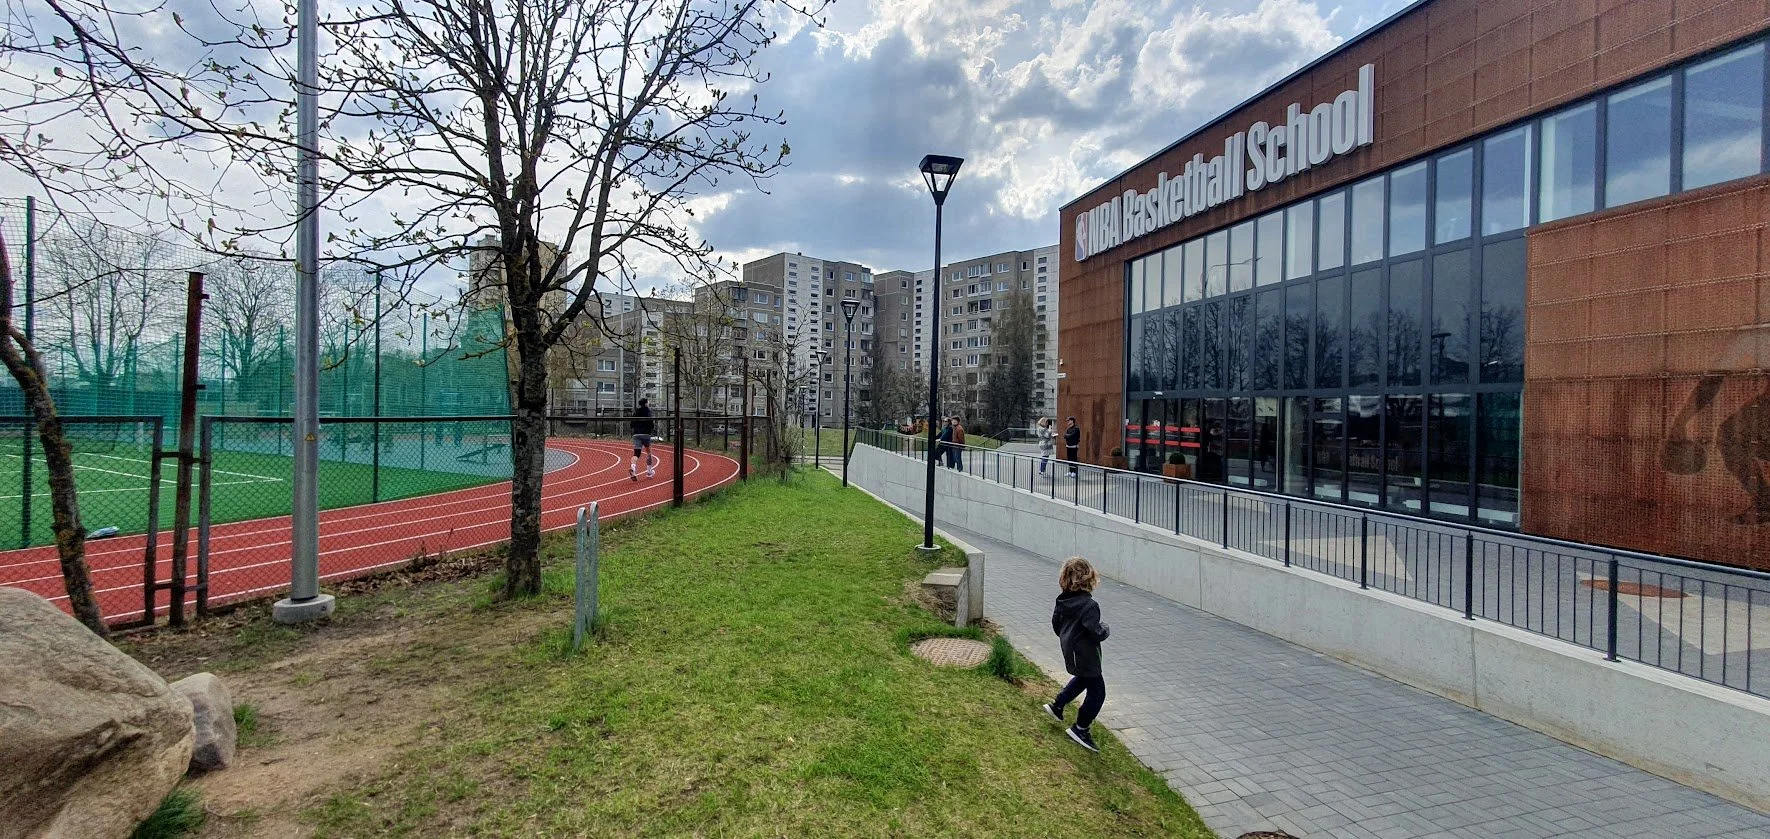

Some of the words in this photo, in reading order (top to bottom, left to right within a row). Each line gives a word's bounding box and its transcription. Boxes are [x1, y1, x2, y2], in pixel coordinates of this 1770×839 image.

[1087, 196, 1123, 257] NBA
[1122, 131, 1246, 243] Basketball
[1246, 63, 1375, 191] School
